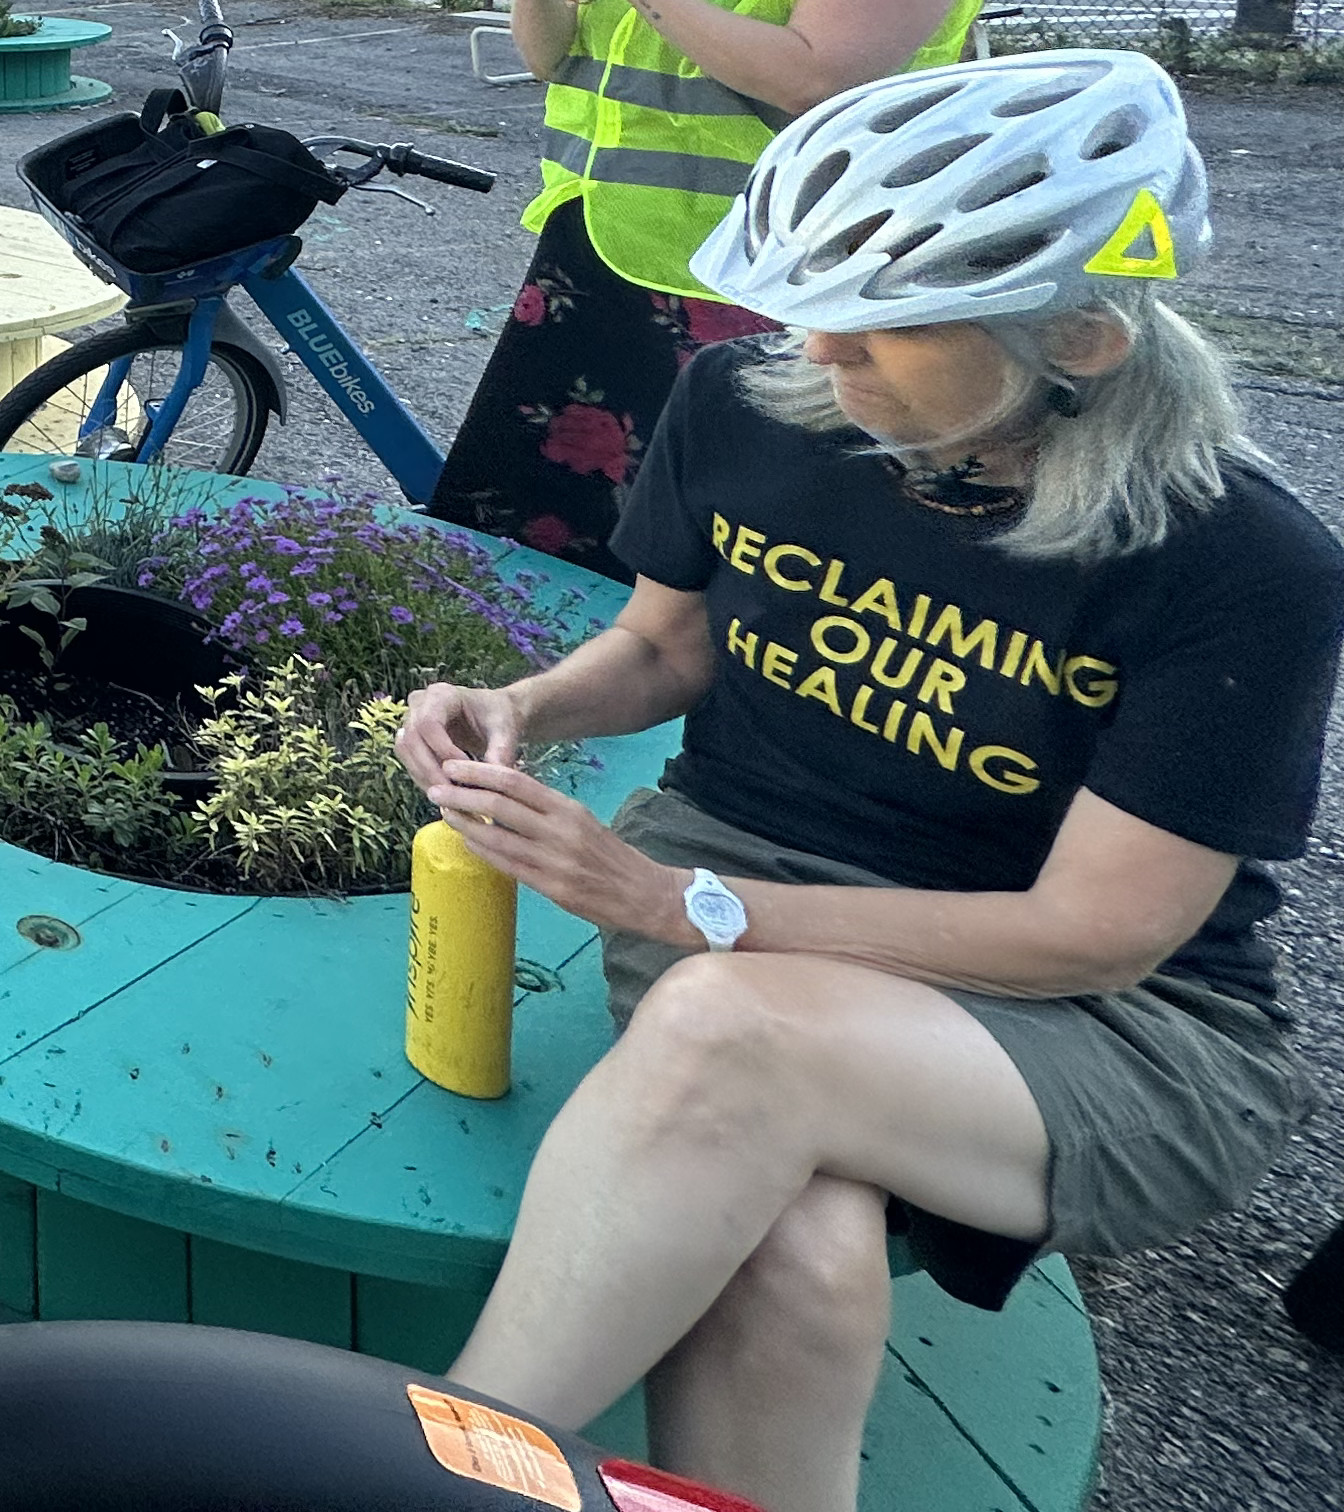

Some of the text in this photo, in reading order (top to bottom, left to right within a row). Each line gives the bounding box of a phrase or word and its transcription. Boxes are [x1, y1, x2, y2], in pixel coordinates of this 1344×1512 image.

[286, 308, 375, 415] BLUEbikes
[712, 511, 1119, 708] RECLAIMING
[726, 616, 1042, 795] HEALING
[810, 615, 966, 715] OUR
[424, 1003, 434, 1023] YES
